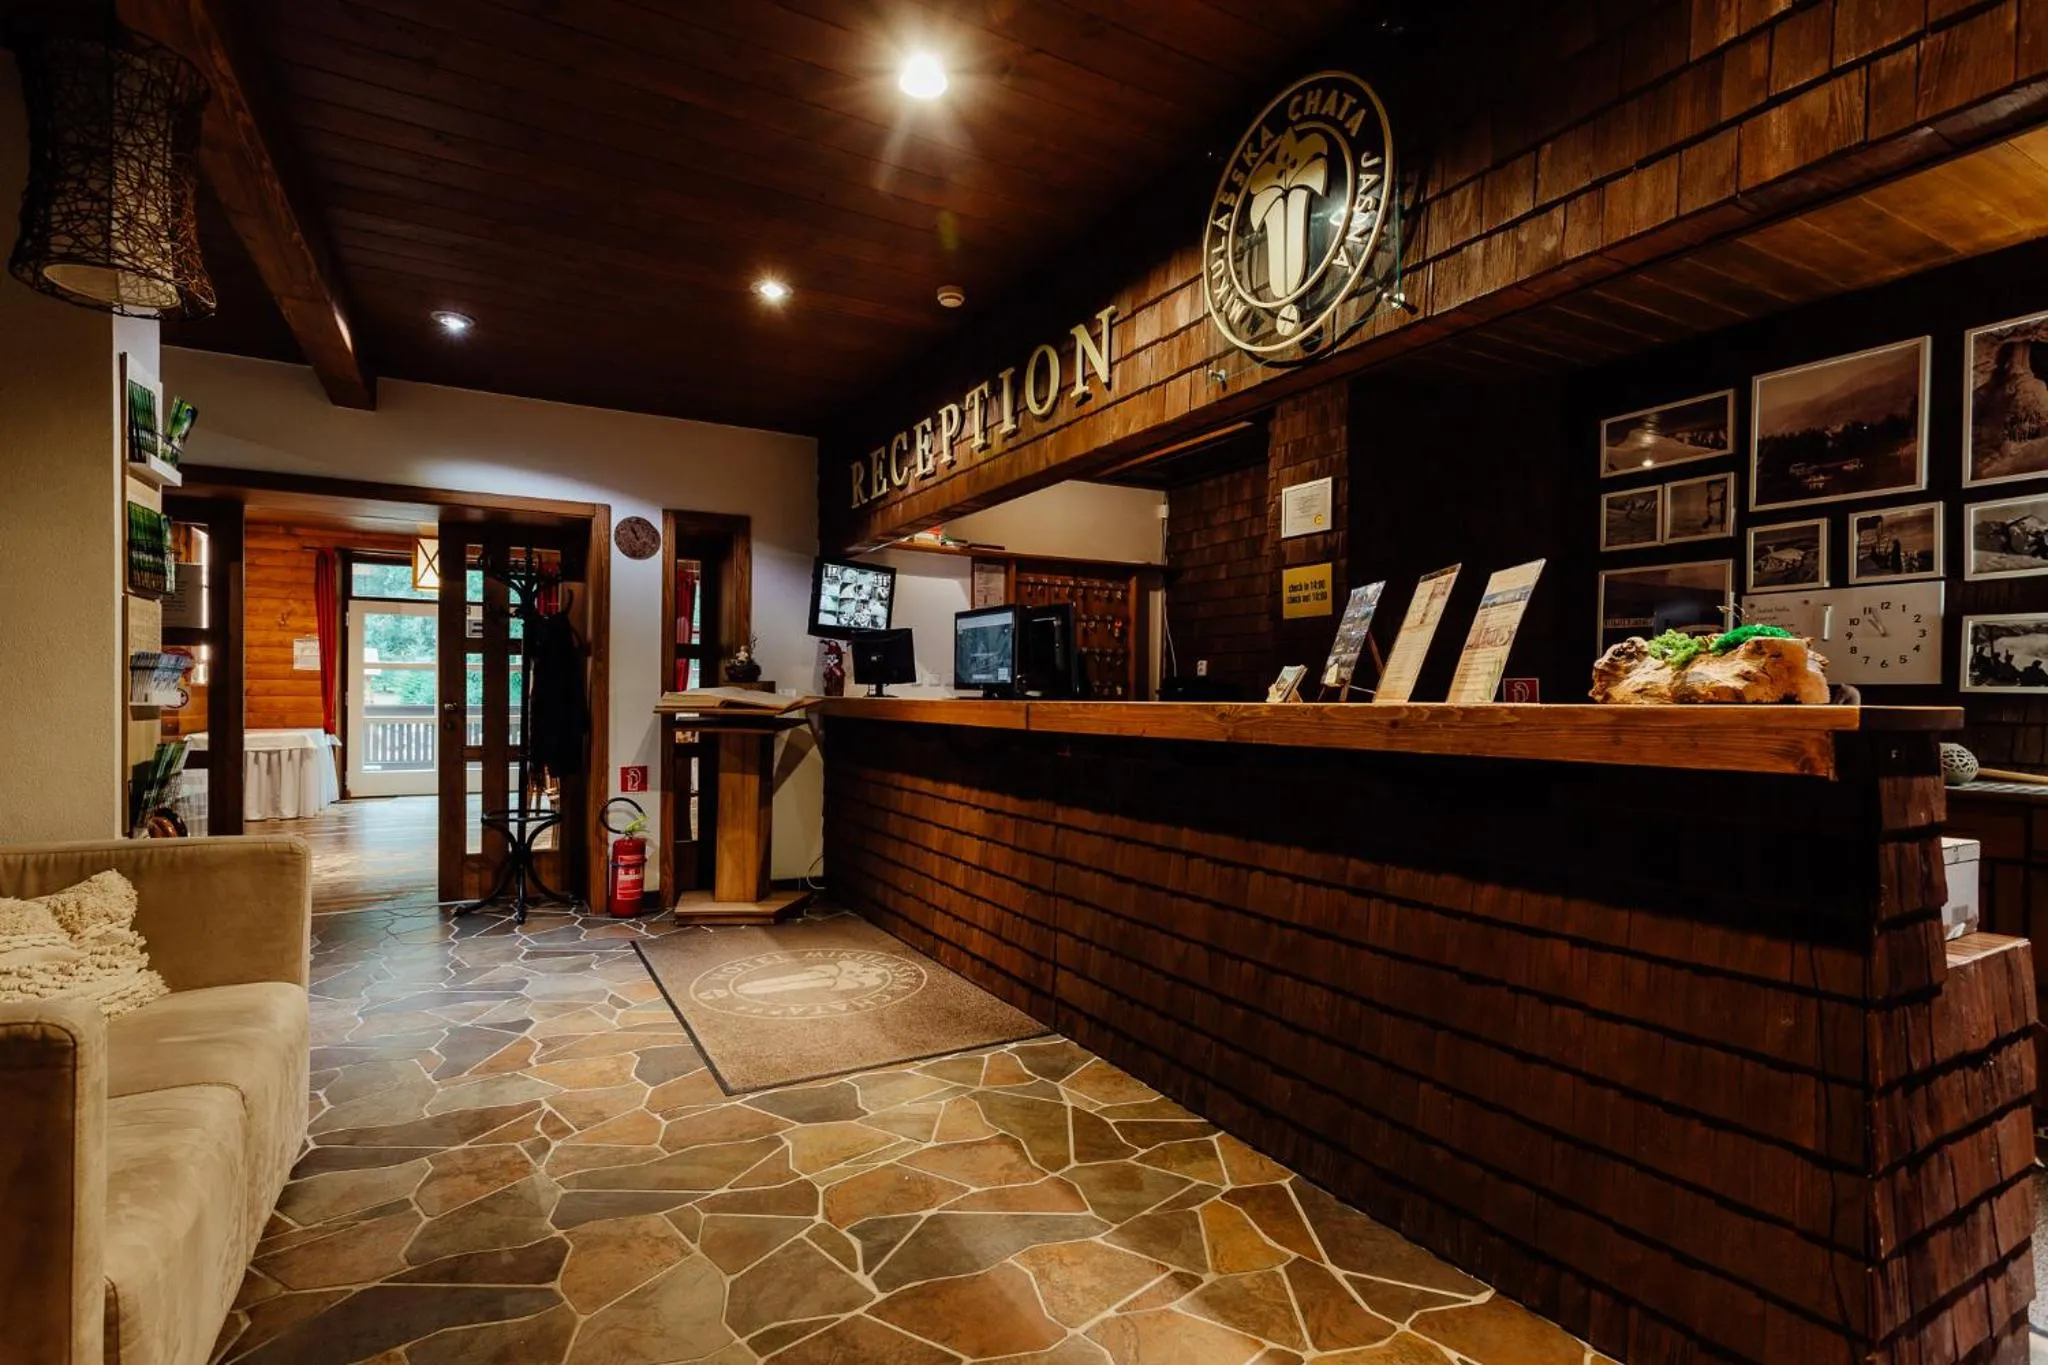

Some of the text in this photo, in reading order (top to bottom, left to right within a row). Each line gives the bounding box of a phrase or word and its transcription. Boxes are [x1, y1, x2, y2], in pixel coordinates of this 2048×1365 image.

[1288, 88, 1368, 138] CHATA
[850, 305, 1118, 509] RECEPTION
[1288, 582, 1303, 593] check
[709, 953, 790, 981] HOTEL
